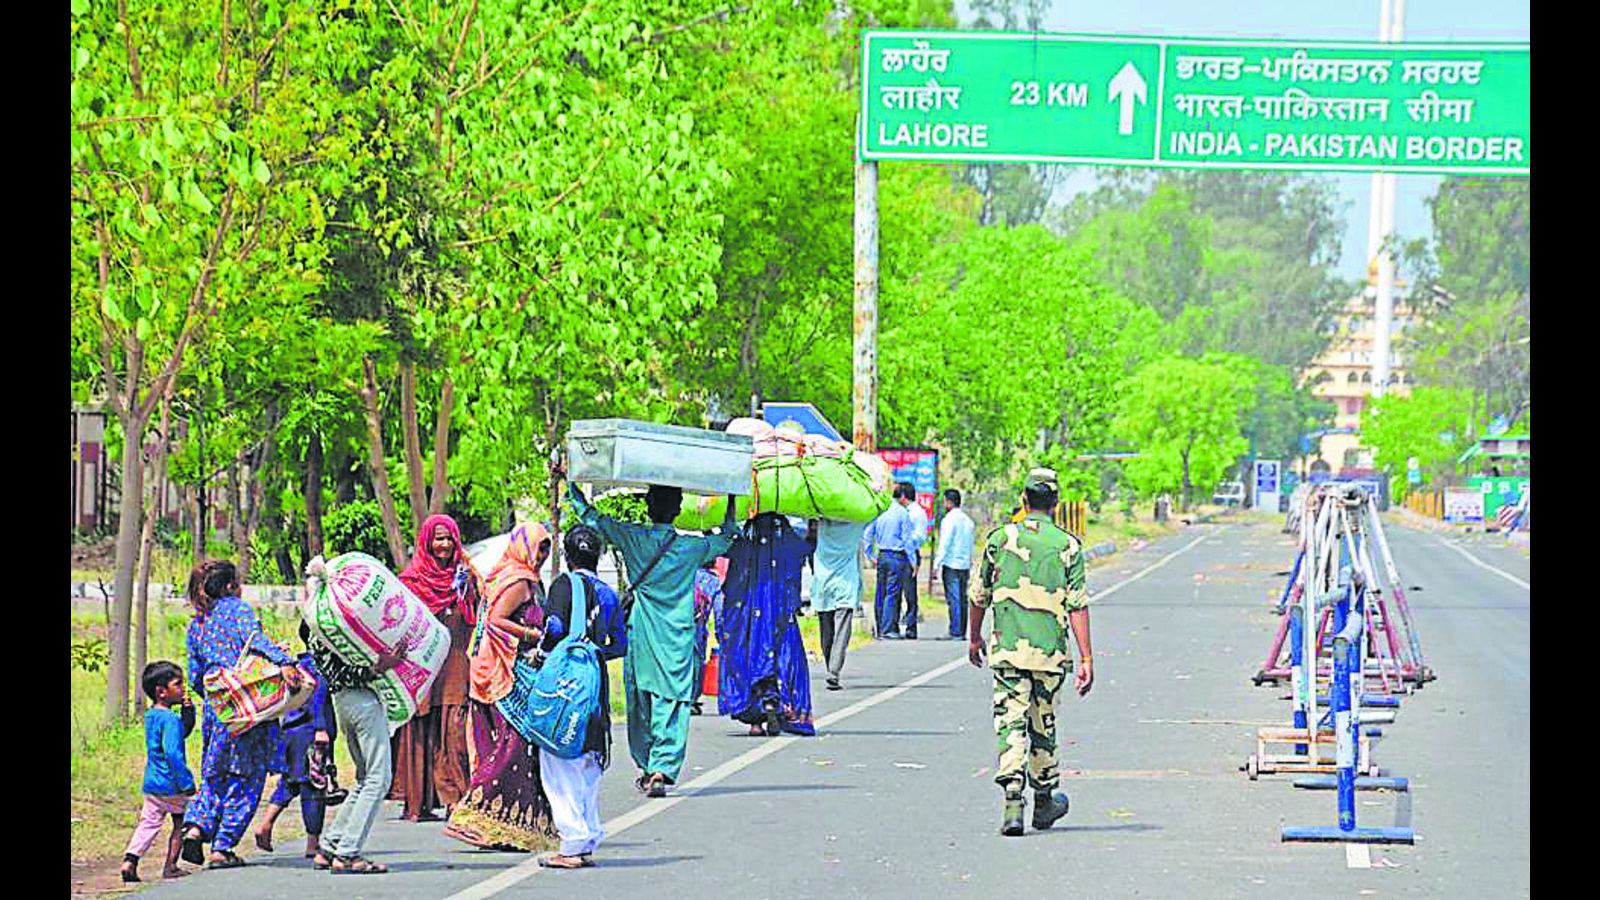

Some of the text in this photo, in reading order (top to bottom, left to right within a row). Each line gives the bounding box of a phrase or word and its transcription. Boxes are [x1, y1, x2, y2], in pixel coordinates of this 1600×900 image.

[881, 38, 951, 73] ਲਾਹੌਰ
[880, 78, 962, 111] लाहौर
[1010, 82, 1089, 107] 23 KM
[1405, 90, 1474, 122] सीमा
[879, 122, 988, 147] LAHORE
[1170, 132, 1243, 156] INDIA
[1265, 133, 1398, 159] PAKISTAN
[1406, 136, 1524, 161] BORDER
[362, 575, 386, 608] FEED
